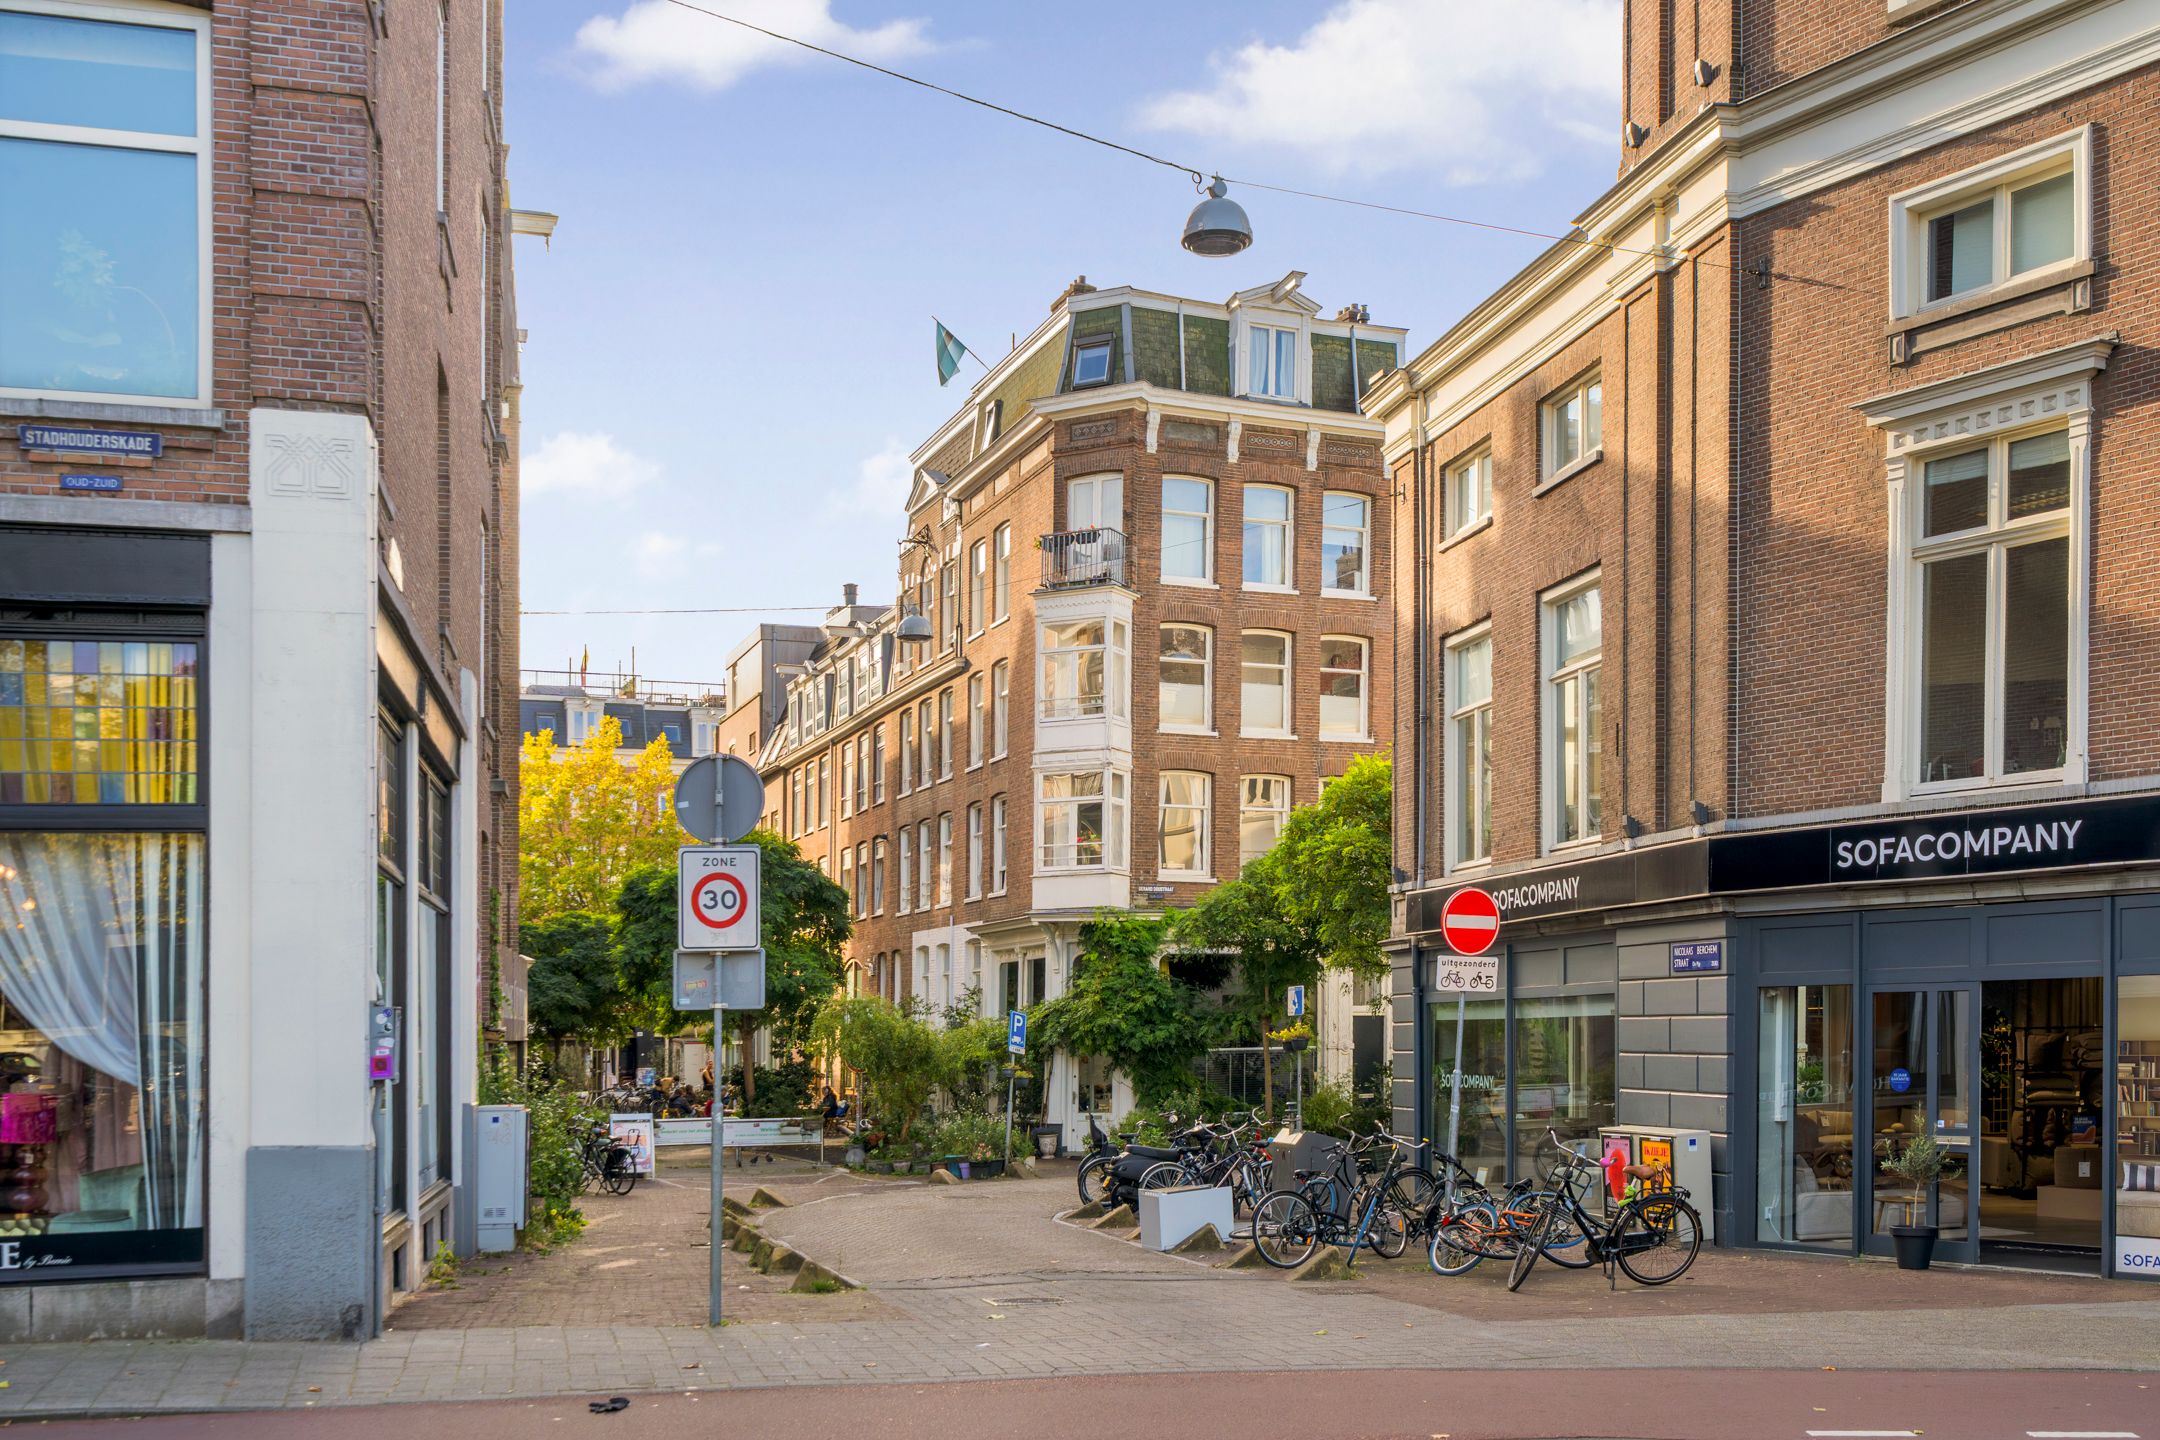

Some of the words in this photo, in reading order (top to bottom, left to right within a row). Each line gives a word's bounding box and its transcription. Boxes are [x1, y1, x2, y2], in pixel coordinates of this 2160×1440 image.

[25, 430, 153, 451] STADHOUDERSKADE
[66, 477, 118, 488] OUD-ZUID
[1836, 819, 2083, 869] SOFACOMPANY
[702, 857, 737, 868] ZONE
[702, 889, 737, 910] 30
[1492, 876, 1580, 911] SOFACOMPANY
[1441, 959, 1496, 968] uitgezonderd
[1674, 958, 1689, 968] STRAAT
[1013, 1014, 1023, 1032] P
[1441, 1073, 1494, 1089] SOFCOMPANY
[2123, 1253, 2160, 1268] SOFA
